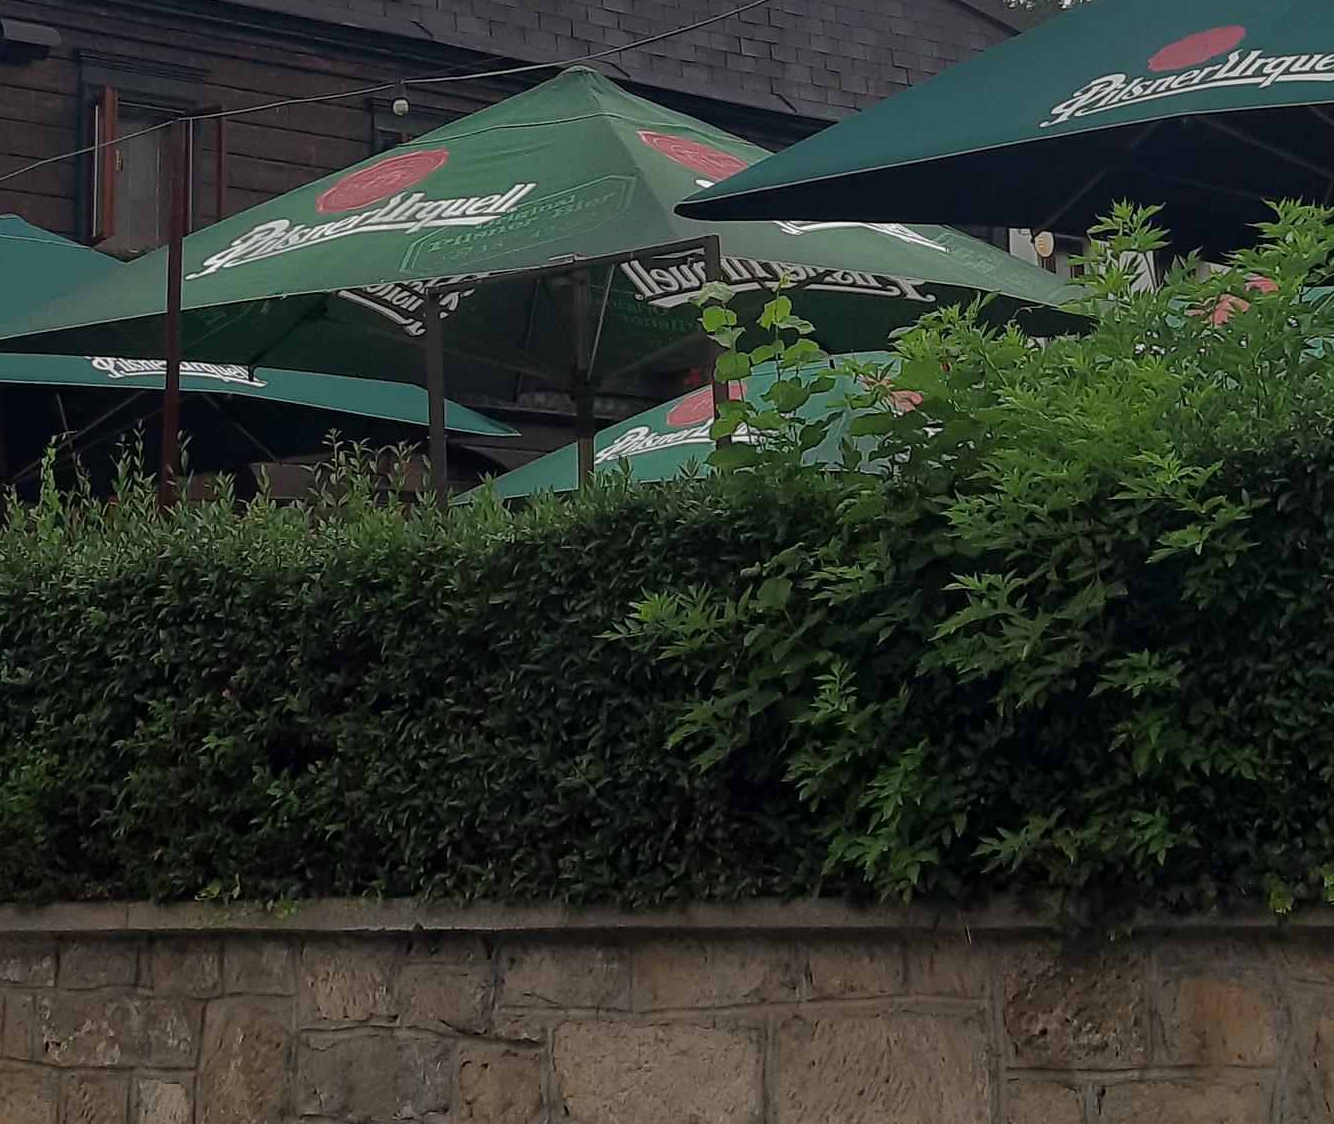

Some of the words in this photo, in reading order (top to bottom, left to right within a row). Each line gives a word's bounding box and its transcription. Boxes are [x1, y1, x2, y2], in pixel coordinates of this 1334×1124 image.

[1039, 73, 1223, 128] Pilsner
[185, 218, 369, 280] Pilsner
[364, 182, 538, 234] Urquell
[83, 356, 167, 379] Pilsne
[594, 426, 697, 464] Pilsner
